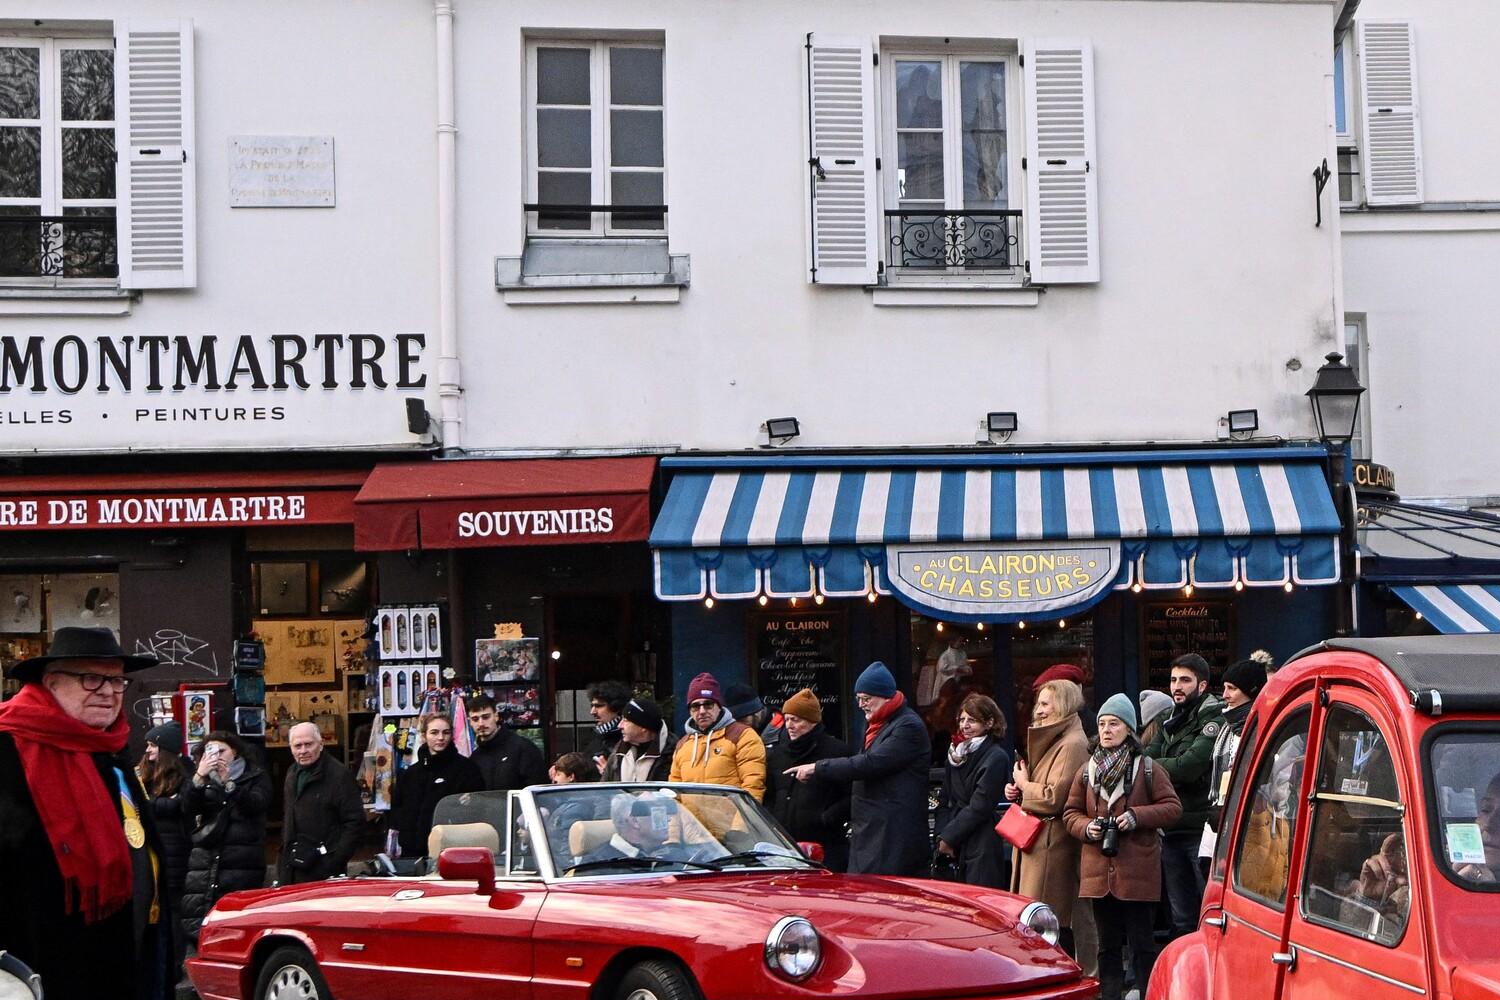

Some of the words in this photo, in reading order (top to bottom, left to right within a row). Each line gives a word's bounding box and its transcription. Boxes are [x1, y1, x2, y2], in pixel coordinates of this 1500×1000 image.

[0, 334, 427, 393] MONTMARTRE
[0, 410, 72, 423] LLES
[136, 407, 285, 421] PEINTURES
[0, 501, 37, 525] RE
[48, 500, 87, 524] DE
[98, 495, 305, 523] MONTMARTRE
[458, 507, 613, 537] SOUVENIRS
[929, 559, 946, 569] AU
[949, 554, 1055, 576] CLAIRON
[1057, 555, 1081, 566] DES
[919, 566, 1091, 598] CHASSEURS
[1165, 606, 1209, 617] Cocktails
[766, 621, 780, 630] AU
[785, 621, 829, 630] CLAIRON
